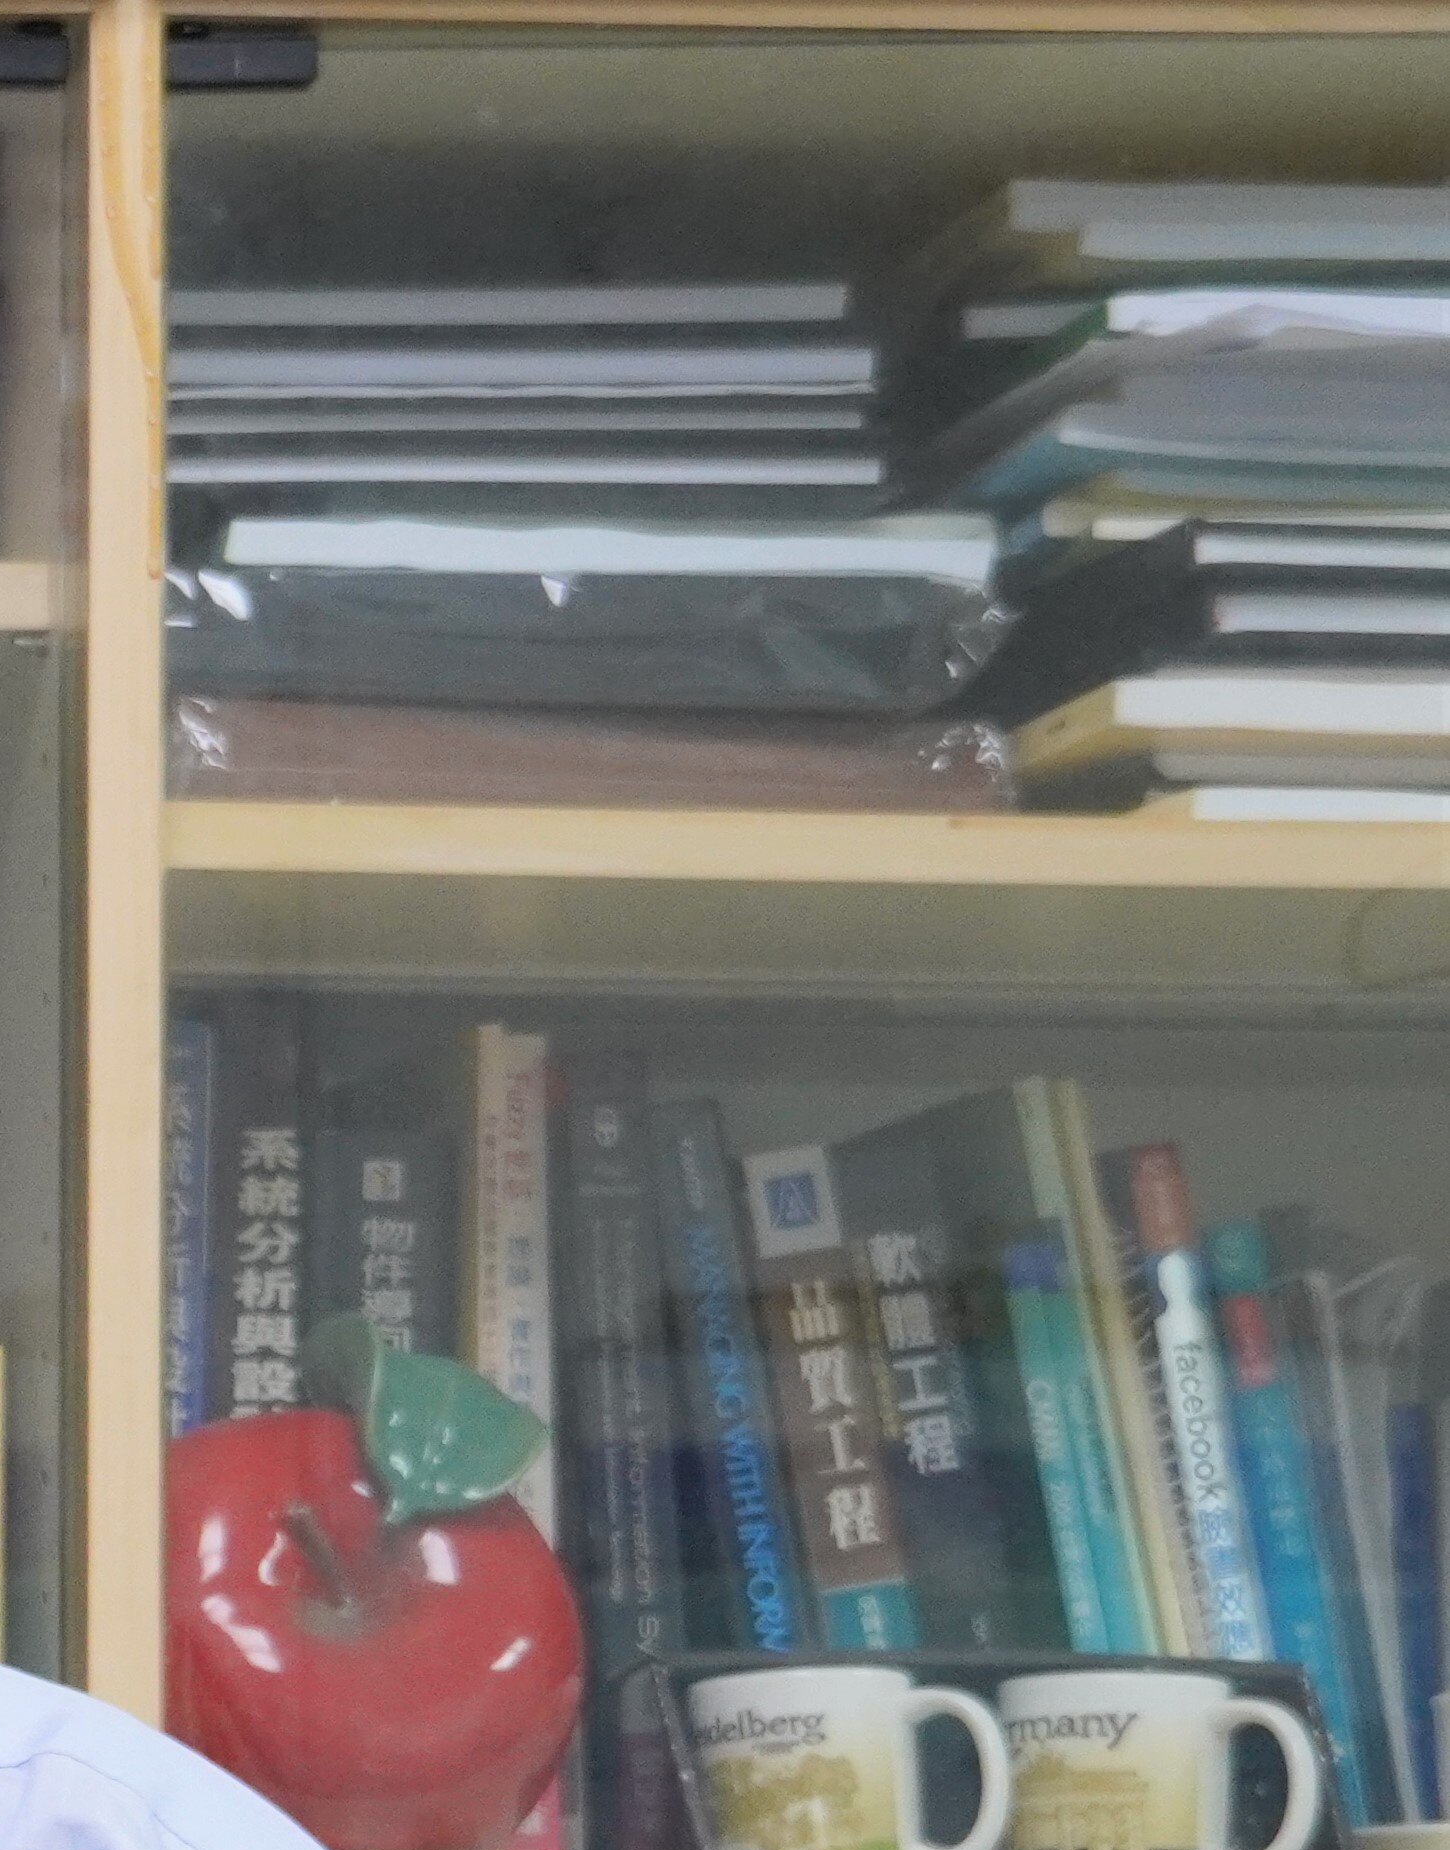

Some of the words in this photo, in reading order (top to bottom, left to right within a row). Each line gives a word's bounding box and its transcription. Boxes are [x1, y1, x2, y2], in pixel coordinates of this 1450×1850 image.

[231, 1127, 300, 1418] 系統分析與設
[868, 1233, 961, 1476] 軟體工程
[718, 1422, 765, 1515] WITH
[790, 1280, 882, 1551] 品質工程
[1174, 1342, 1230, 1508] facebook
[627, 1425, 657, 1604] Information
[633, 1615, 662, 1656] Sy
